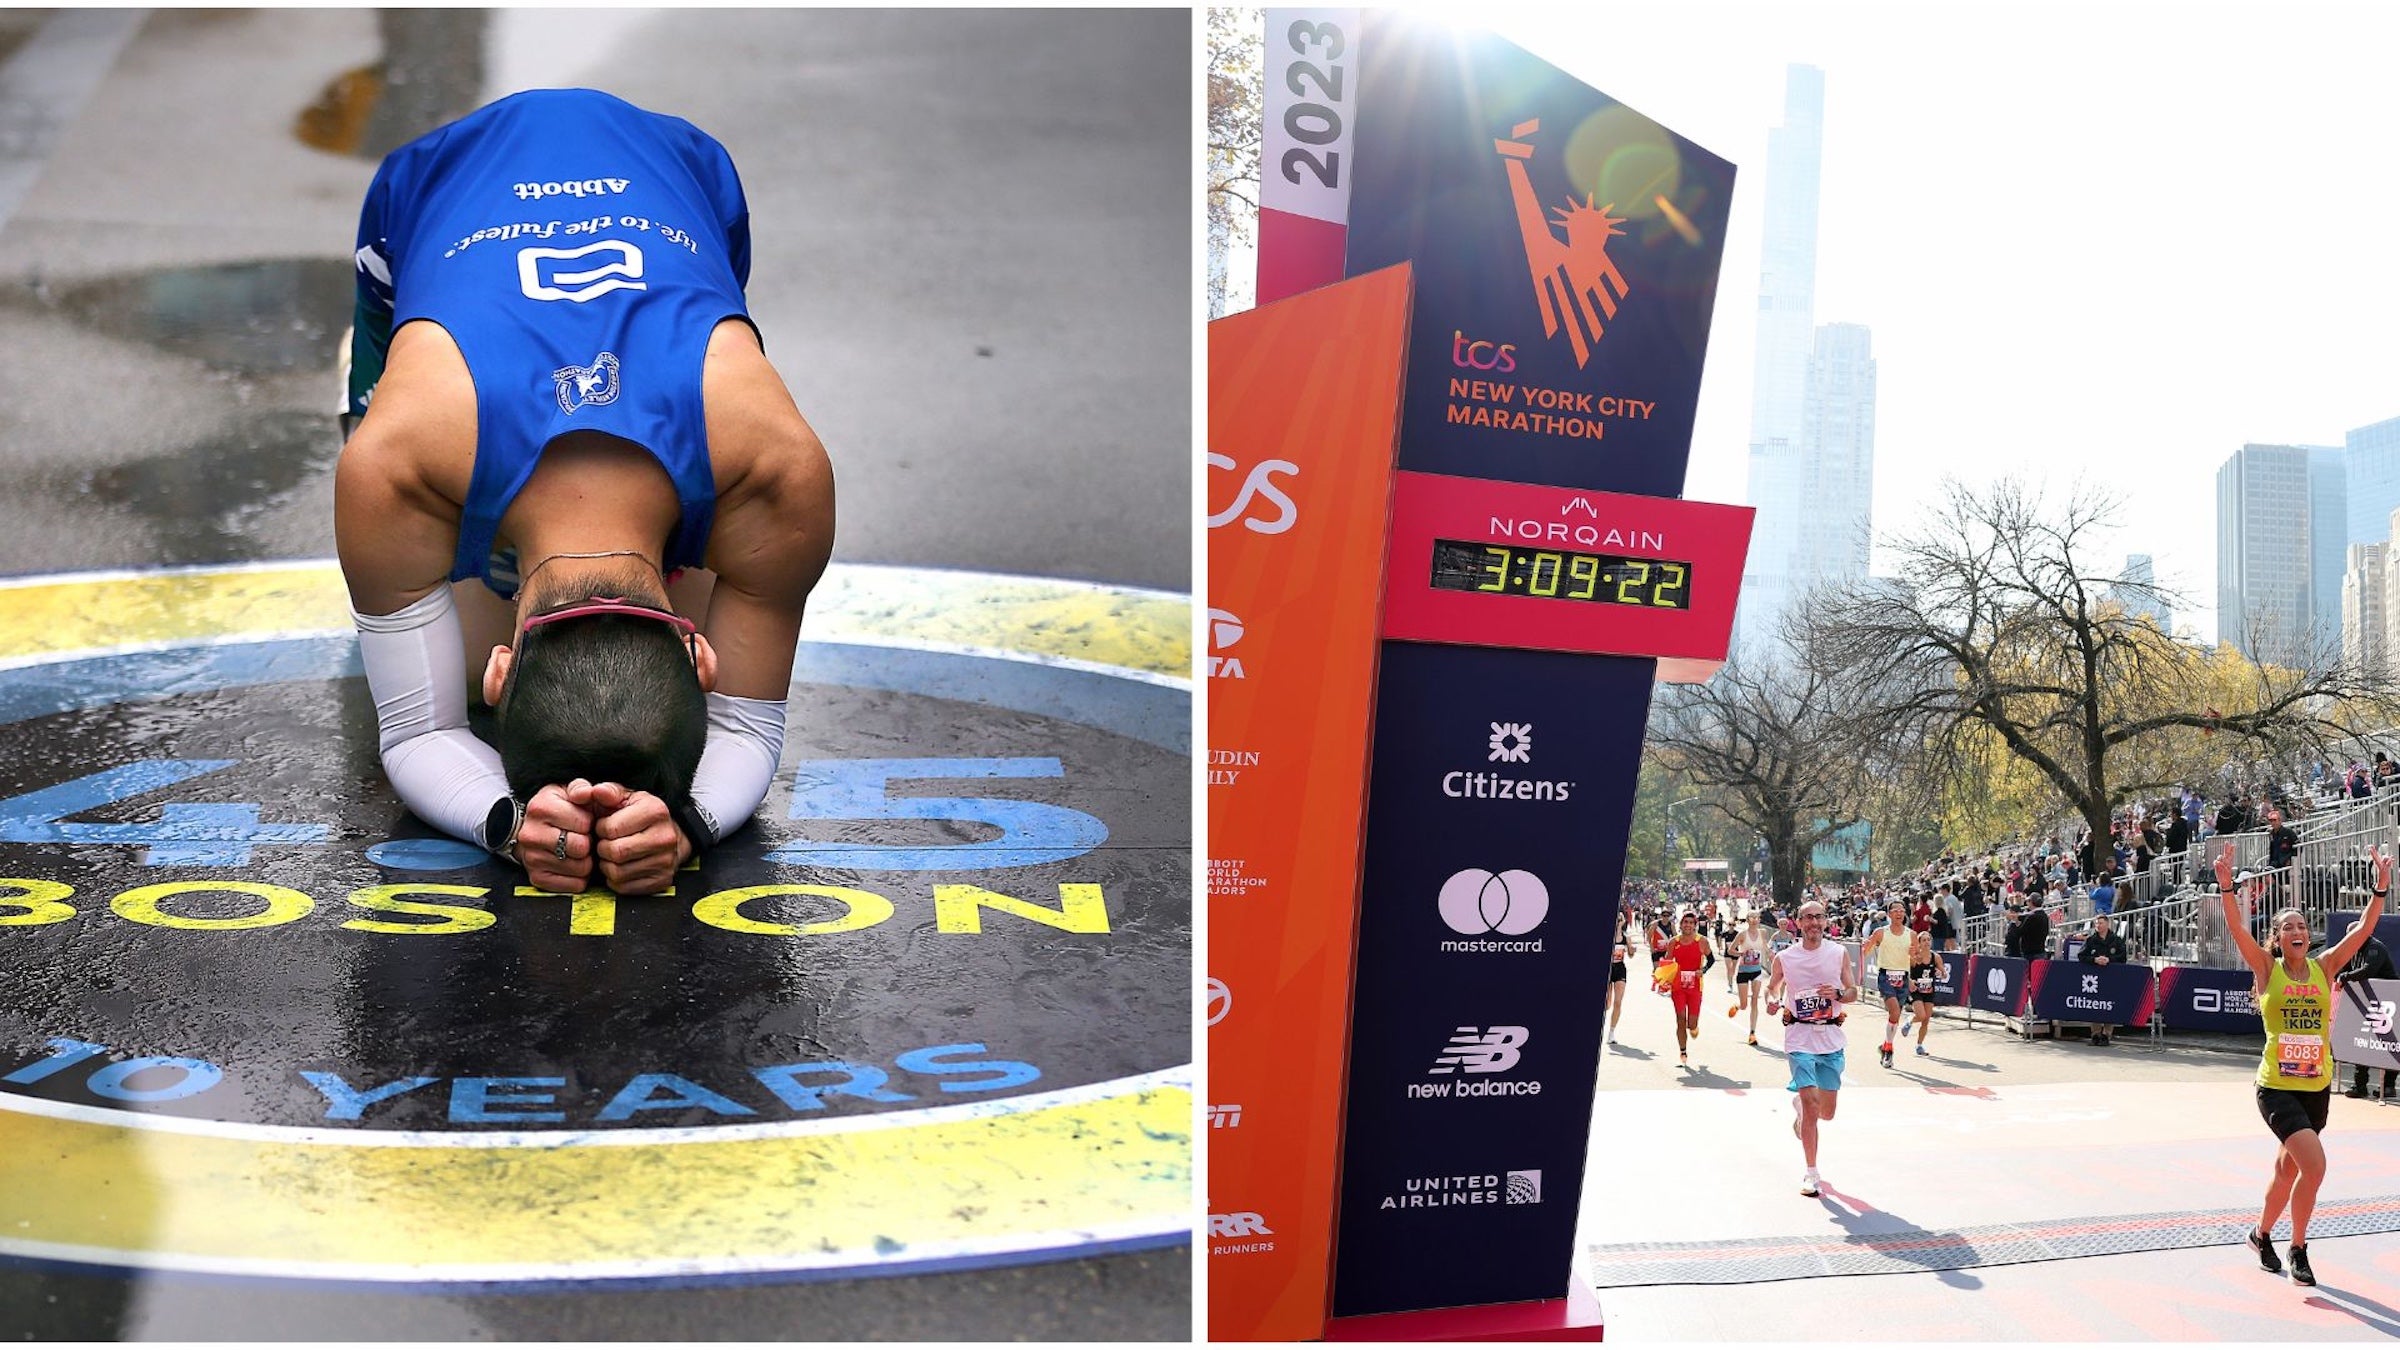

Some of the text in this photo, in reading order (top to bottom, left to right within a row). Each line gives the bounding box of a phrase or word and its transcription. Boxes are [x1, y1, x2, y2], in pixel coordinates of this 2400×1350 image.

[1280, 18, 1345, 189] 2023
[513, 177, 631, 200] Abbott
[564, 214, 613, 236] the
[619, 215, 652, 231] to
[1448, 377, 1656, 421] NEW YORK CITY
[1446, 404, 1604, 440] MARATHON
[1489, 516, 1665, 551] NORQAIN
[1441, 770, 1571, 802] Citizens
[1440, 937, 1545, 954] mastercard
[1800, 996, 1828, 1010] 3574
[2065, 995, 2113, 1012] Citizens
[2280, 1008, 2323, 1018] TEAM
[2289, 1019, 2322, 1030] KIDS
[2284, 1044, 2320, 1060] 6083
[2353, 1036, 2400, 1052] new balance
[2, 1037, 1043, 1123] 10 YEARS
[1407, 1078, 1542, 1100] new balance
[1406, 1174, 1499, 1192] UNITED
[1380, 1190, 1499, 1210] AIRLINES
[1214, 1241, 1275, 1255] RUNNERS
